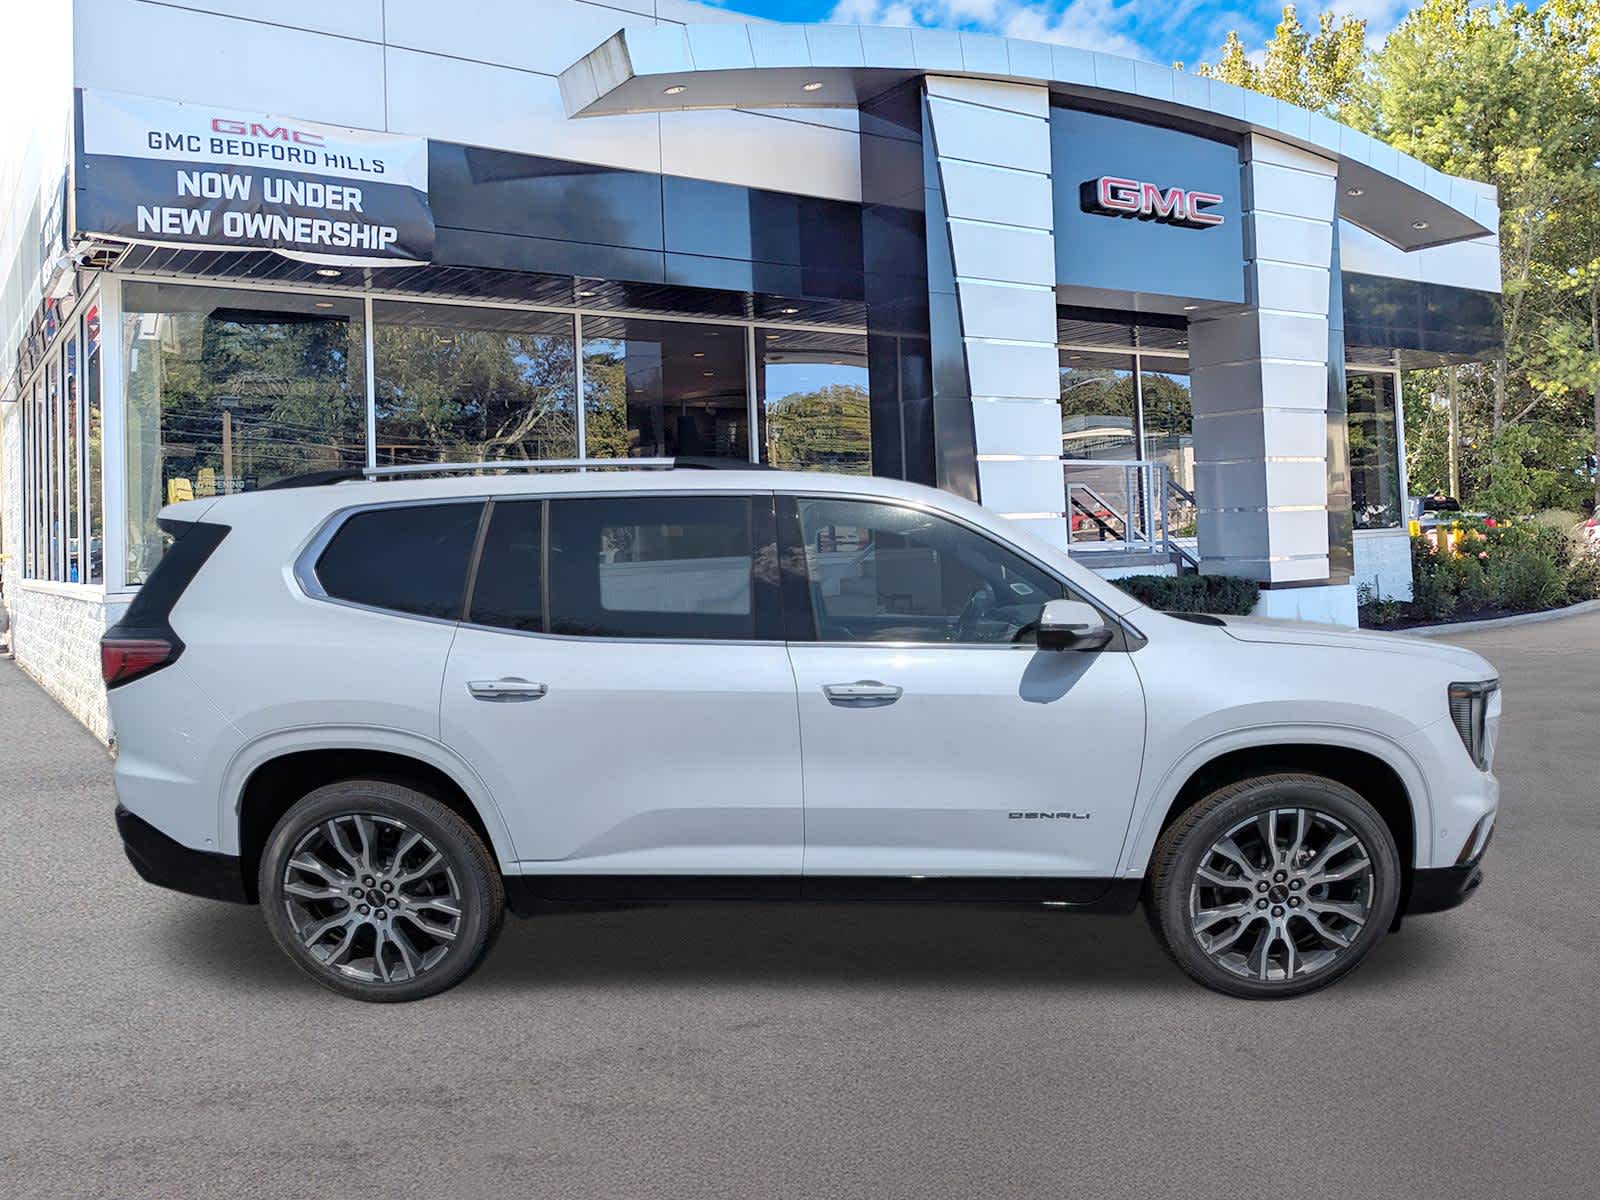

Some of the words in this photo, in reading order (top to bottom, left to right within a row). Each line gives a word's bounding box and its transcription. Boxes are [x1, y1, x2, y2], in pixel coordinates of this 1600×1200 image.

[147, 131, 201, 153] GMC
[209, 137, 316, 165] BEDFORD
[324, 152, 385, 174] HILLS
[211, 118, 326, 148] GMC
[176, 170, 252, 201] NOW
[263, 176, 364, 213] UNDER
[1098, 175, 1225, 225] GMC
[136, 205, 212, 236] NEW
[222, 211, 398, 250] OWNERSHIP
[1008, 812, 1090, 820] DENALI
